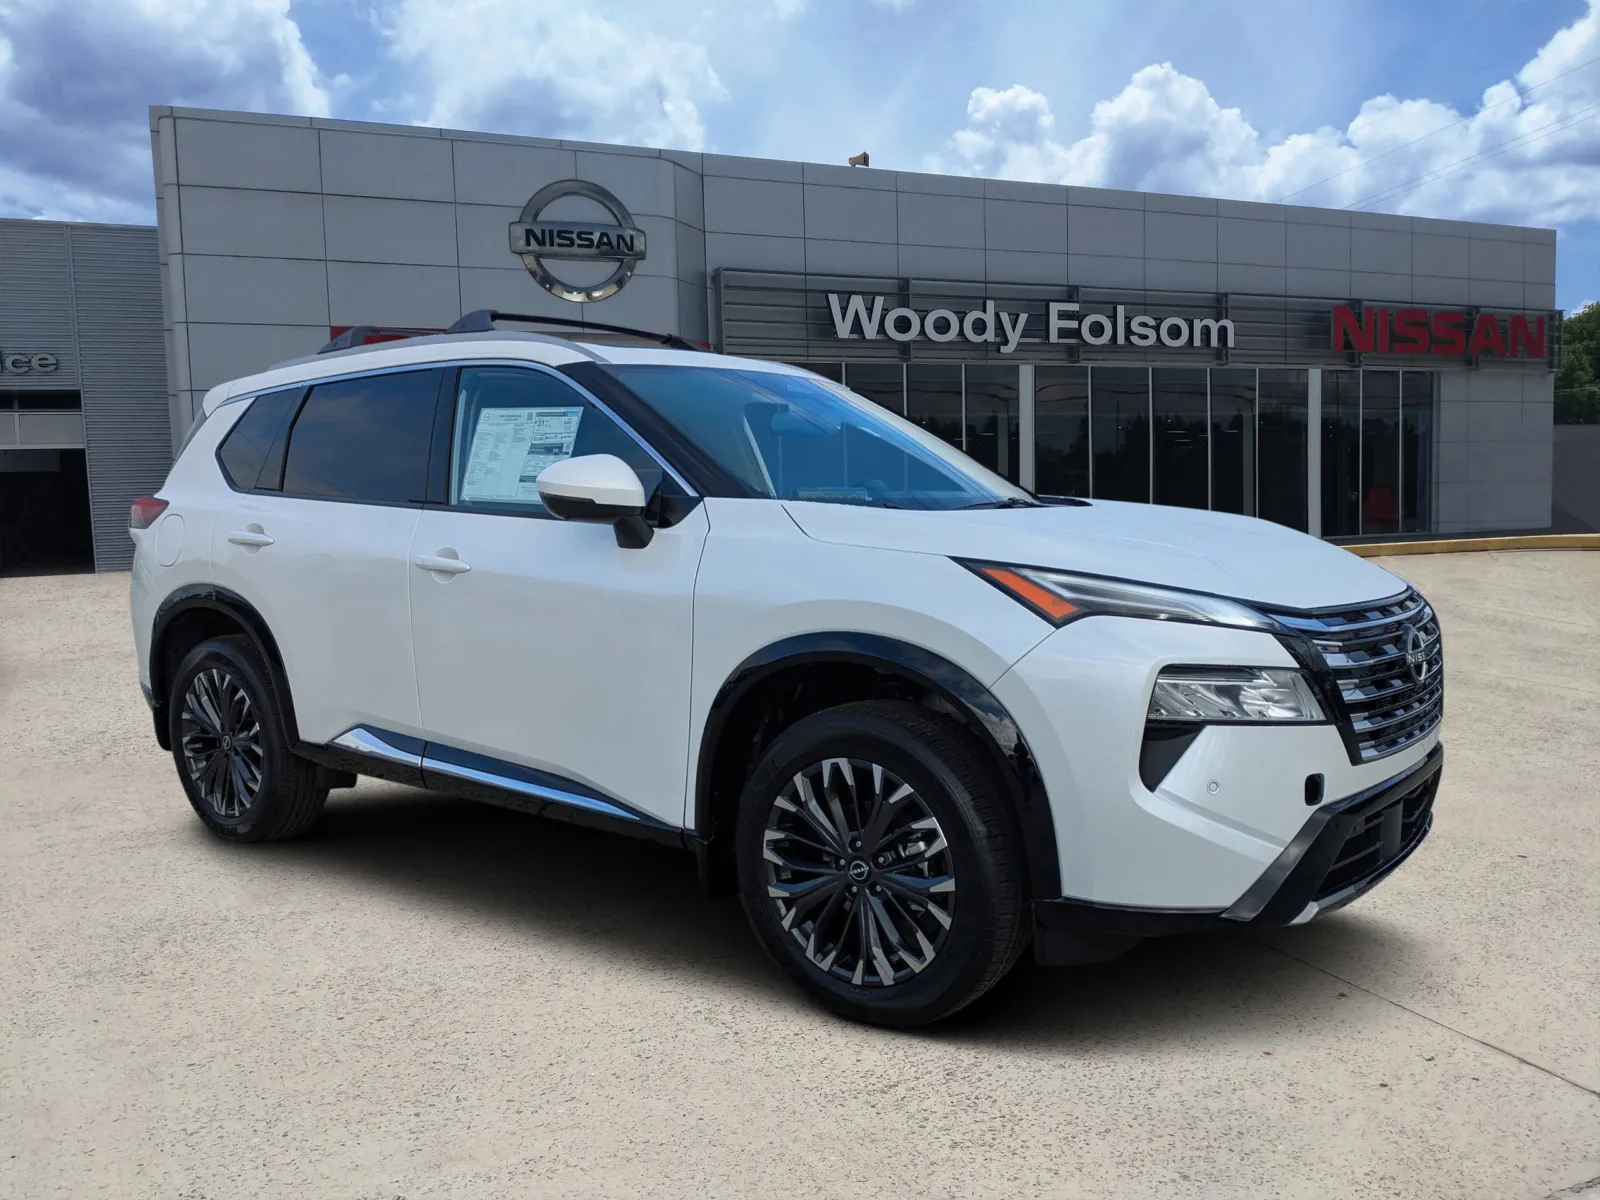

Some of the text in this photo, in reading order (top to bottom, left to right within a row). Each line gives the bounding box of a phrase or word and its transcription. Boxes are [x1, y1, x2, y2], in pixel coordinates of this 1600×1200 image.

[525, 228, 634, 252] NISSAN
[827, 293, 1236, 353] Woody Folsom
[1332, 304, 1545, 358] NISSAN
[0, 353, 57, 374] ce
